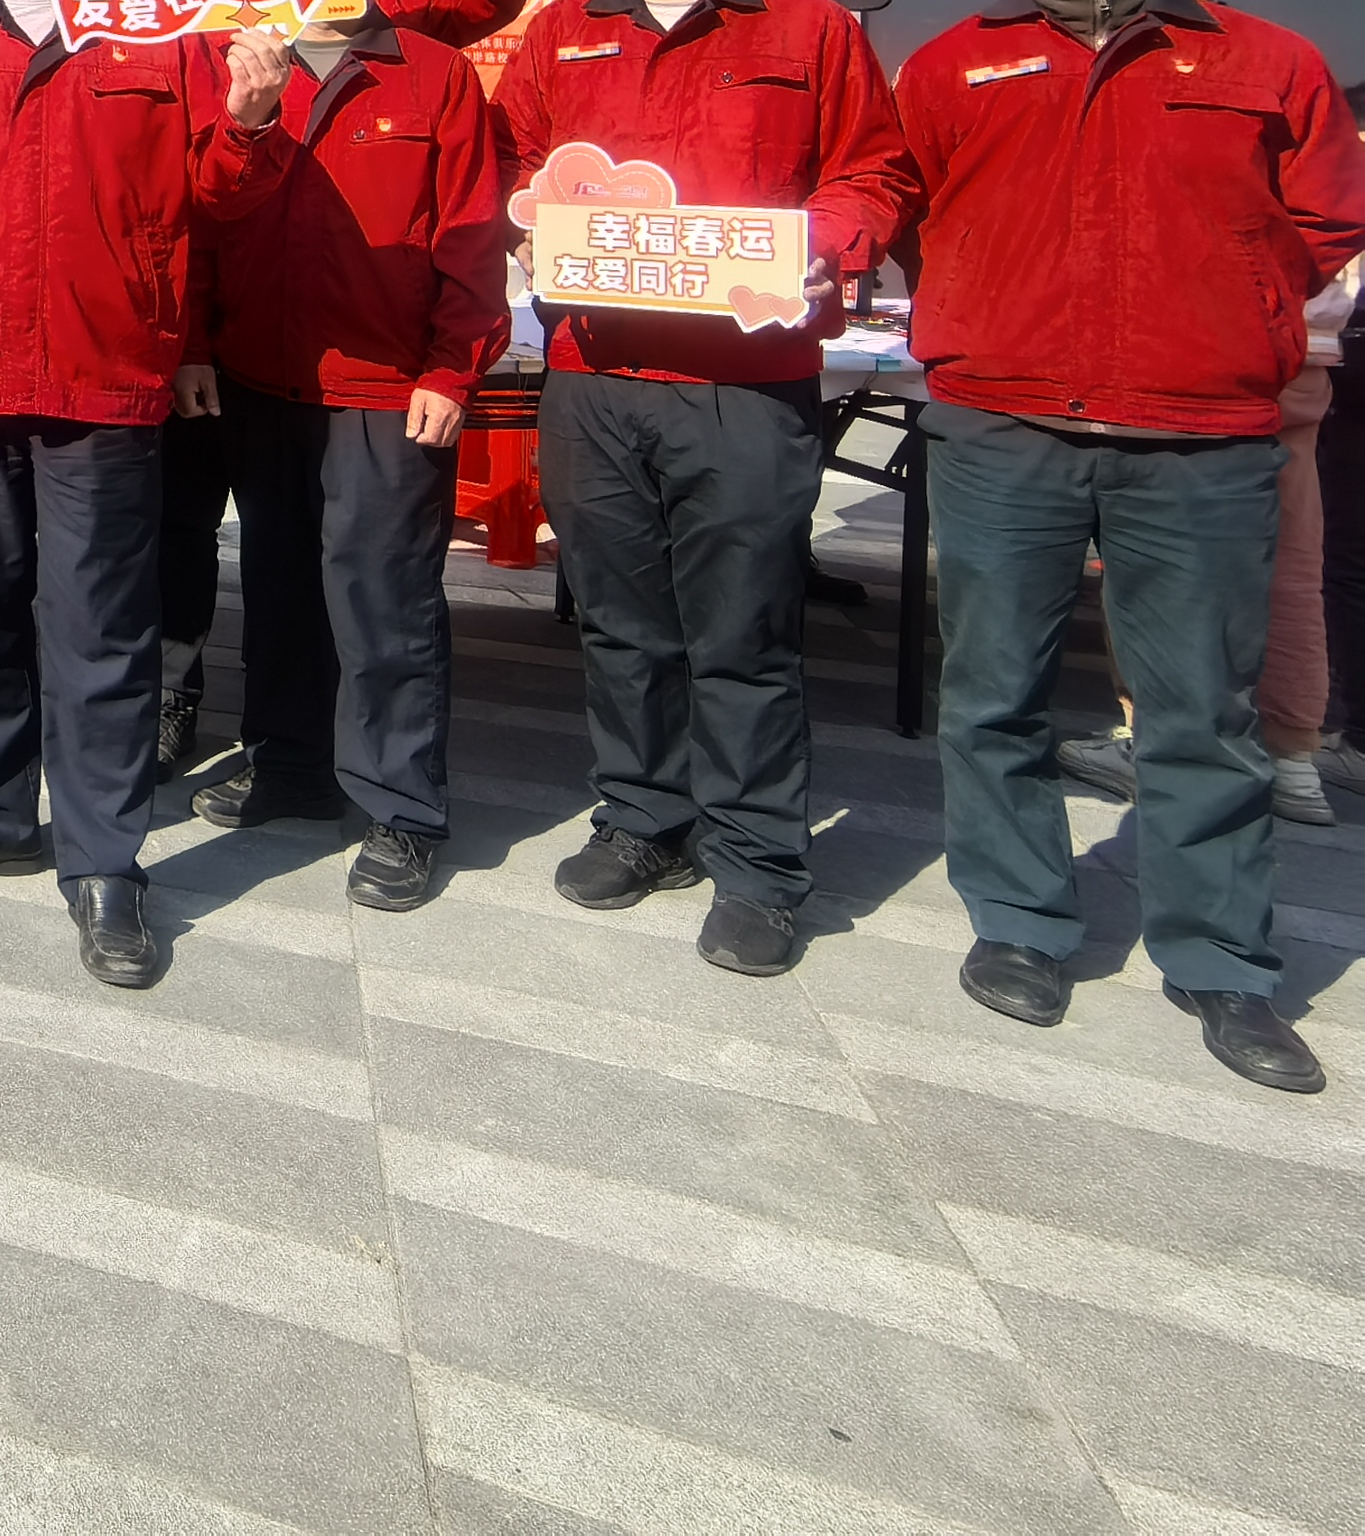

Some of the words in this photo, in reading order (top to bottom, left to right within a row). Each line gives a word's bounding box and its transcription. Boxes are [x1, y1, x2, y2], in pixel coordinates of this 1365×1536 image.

[588, 211, 775, 261] 幸福春运
[552, 255, 709, 298] 友爱同行
